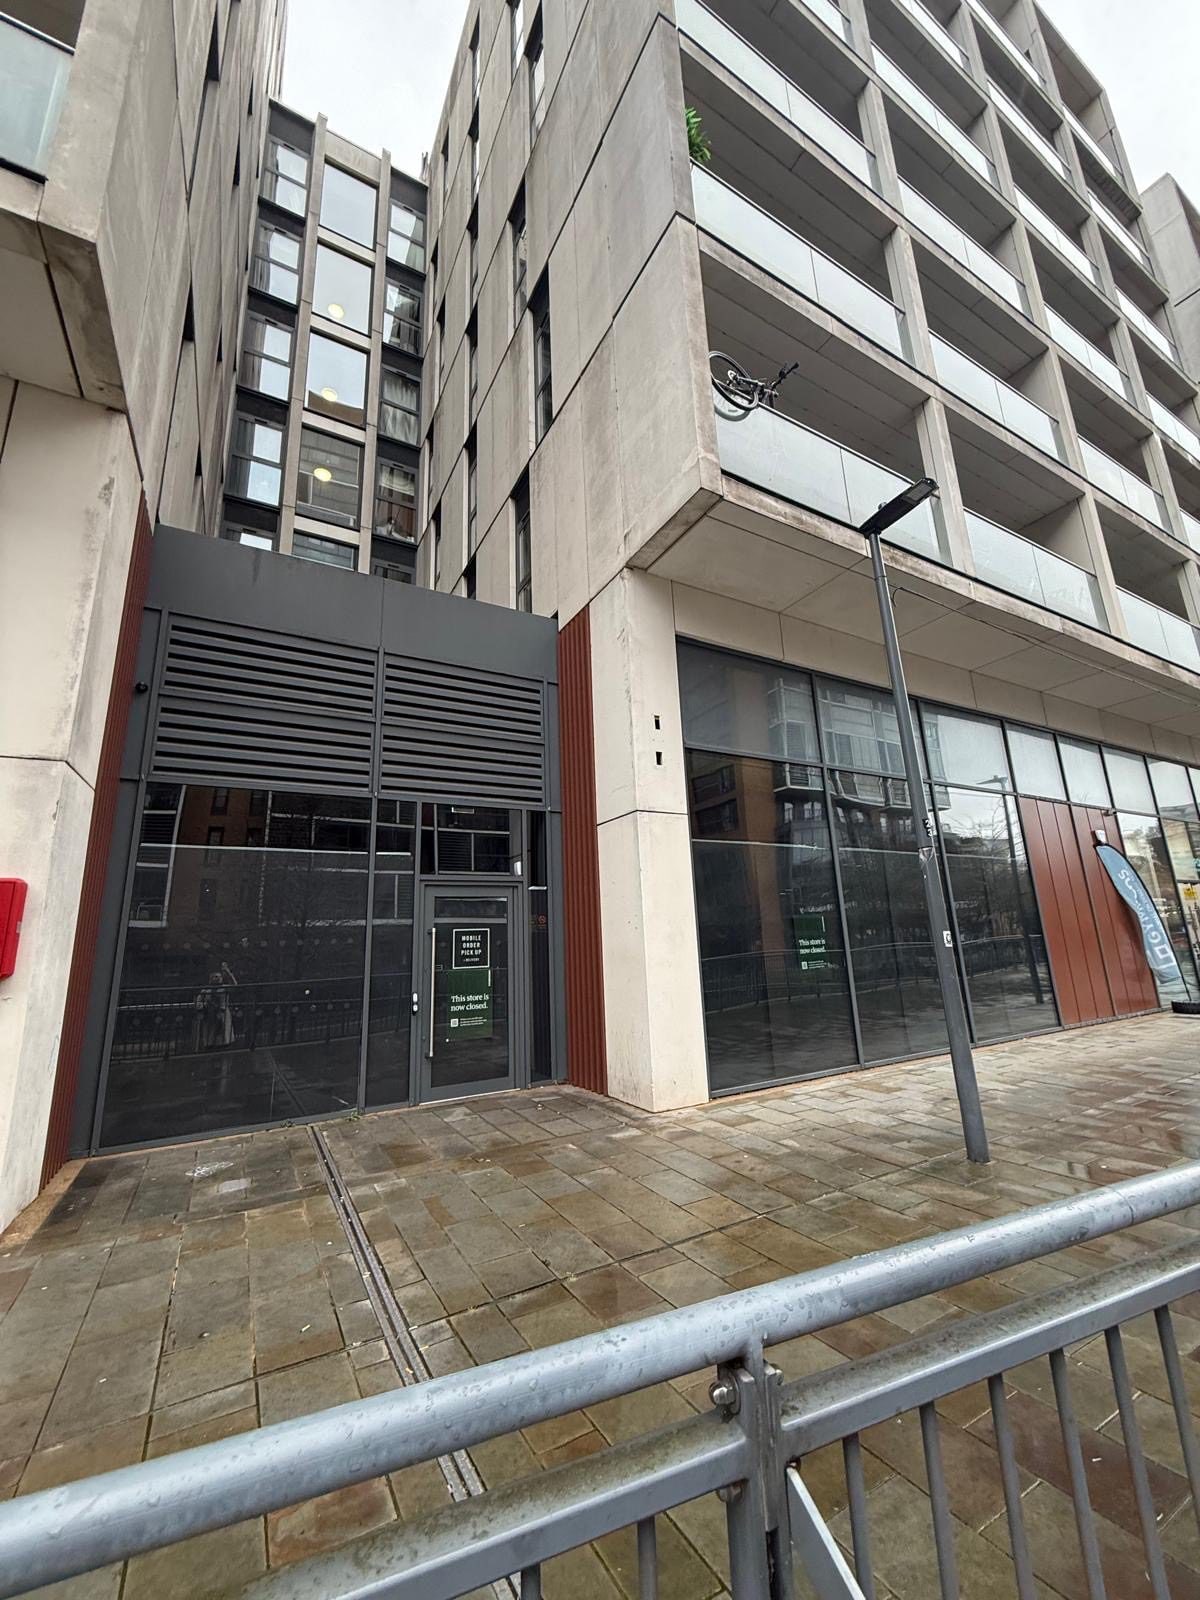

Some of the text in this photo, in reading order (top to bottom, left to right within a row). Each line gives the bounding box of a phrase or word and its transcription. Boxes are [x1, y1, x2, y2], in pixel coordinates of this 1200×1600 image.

[451, 995, 466, 1003] This
[466, 994, 483, 1002] store
[466, 1002, 488, 1010] closed.
